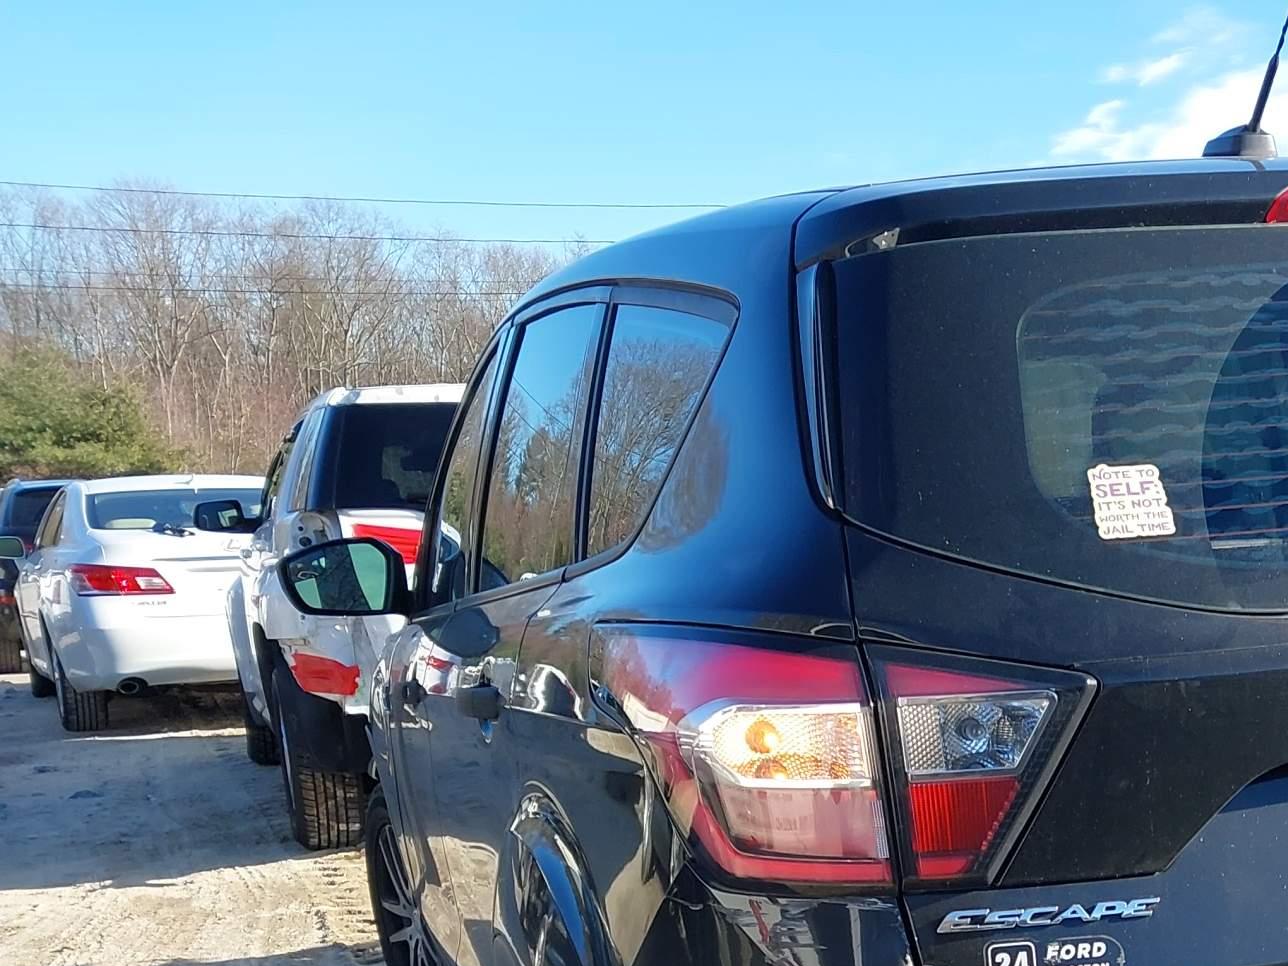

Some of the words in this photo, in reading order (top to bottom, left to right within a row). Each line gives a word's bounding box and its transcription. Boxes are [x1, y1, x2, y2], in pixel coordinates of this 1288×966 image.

[1092, 468, 1132, 481] NOTE
[1136, 469, 1154, 478] TO
[1095, 481, 1160, 498] SELF:
[1098, 500, 1126, 511] IT'S
[1131, 498, 1162, 509] NOT
[1099, 513, 1140, 522] WORTH
[1144, 511, 1168, 520] THE
[1103, 524, 1134, 535] JAIL
[1137, 522, 1171, 532] TIME
[937, 897, 1161, 933] ESCAPE
[1046, 942, 1107, 962] FORD
